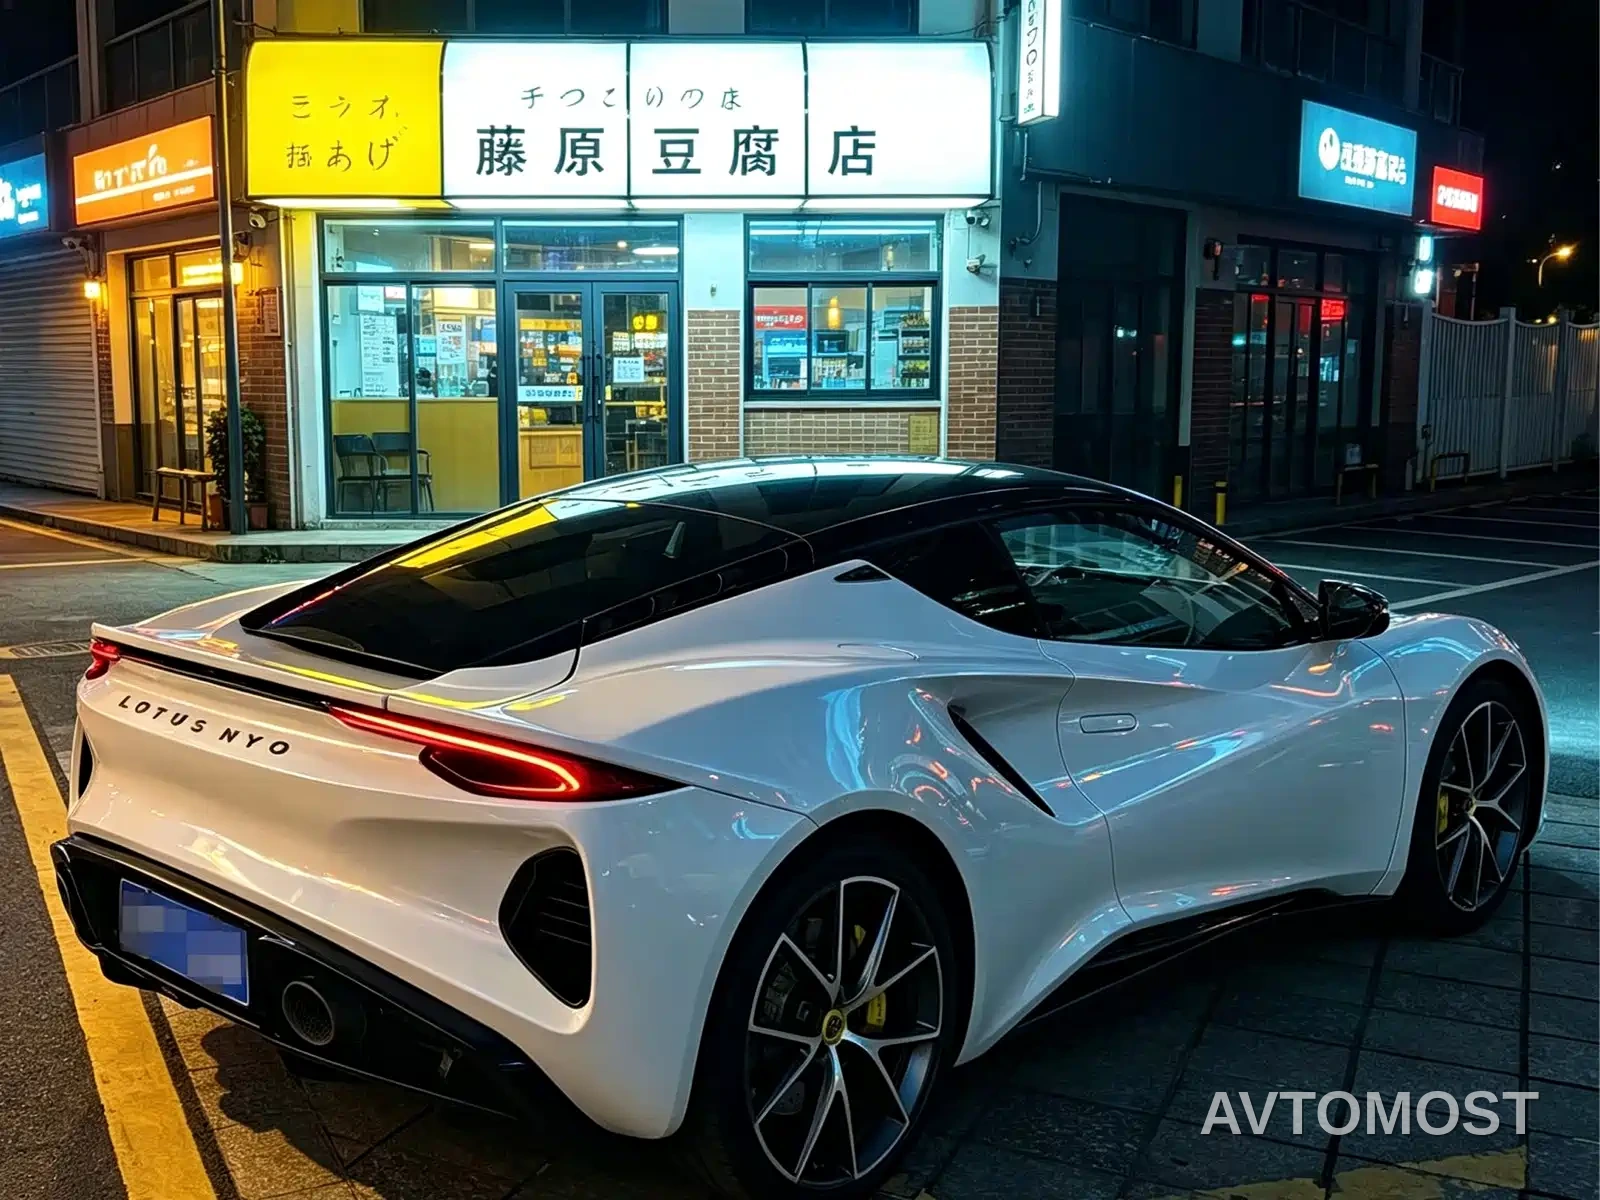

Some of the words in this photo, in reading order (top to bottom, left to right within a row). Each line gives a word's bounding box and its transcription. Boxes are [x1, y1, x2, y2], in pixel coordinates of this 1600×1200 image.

[476, 125, 876, 176] 藤原豆腐店
[118, 695, 207, 733] LOTUS
[218, 727, 290, 755] NYO
